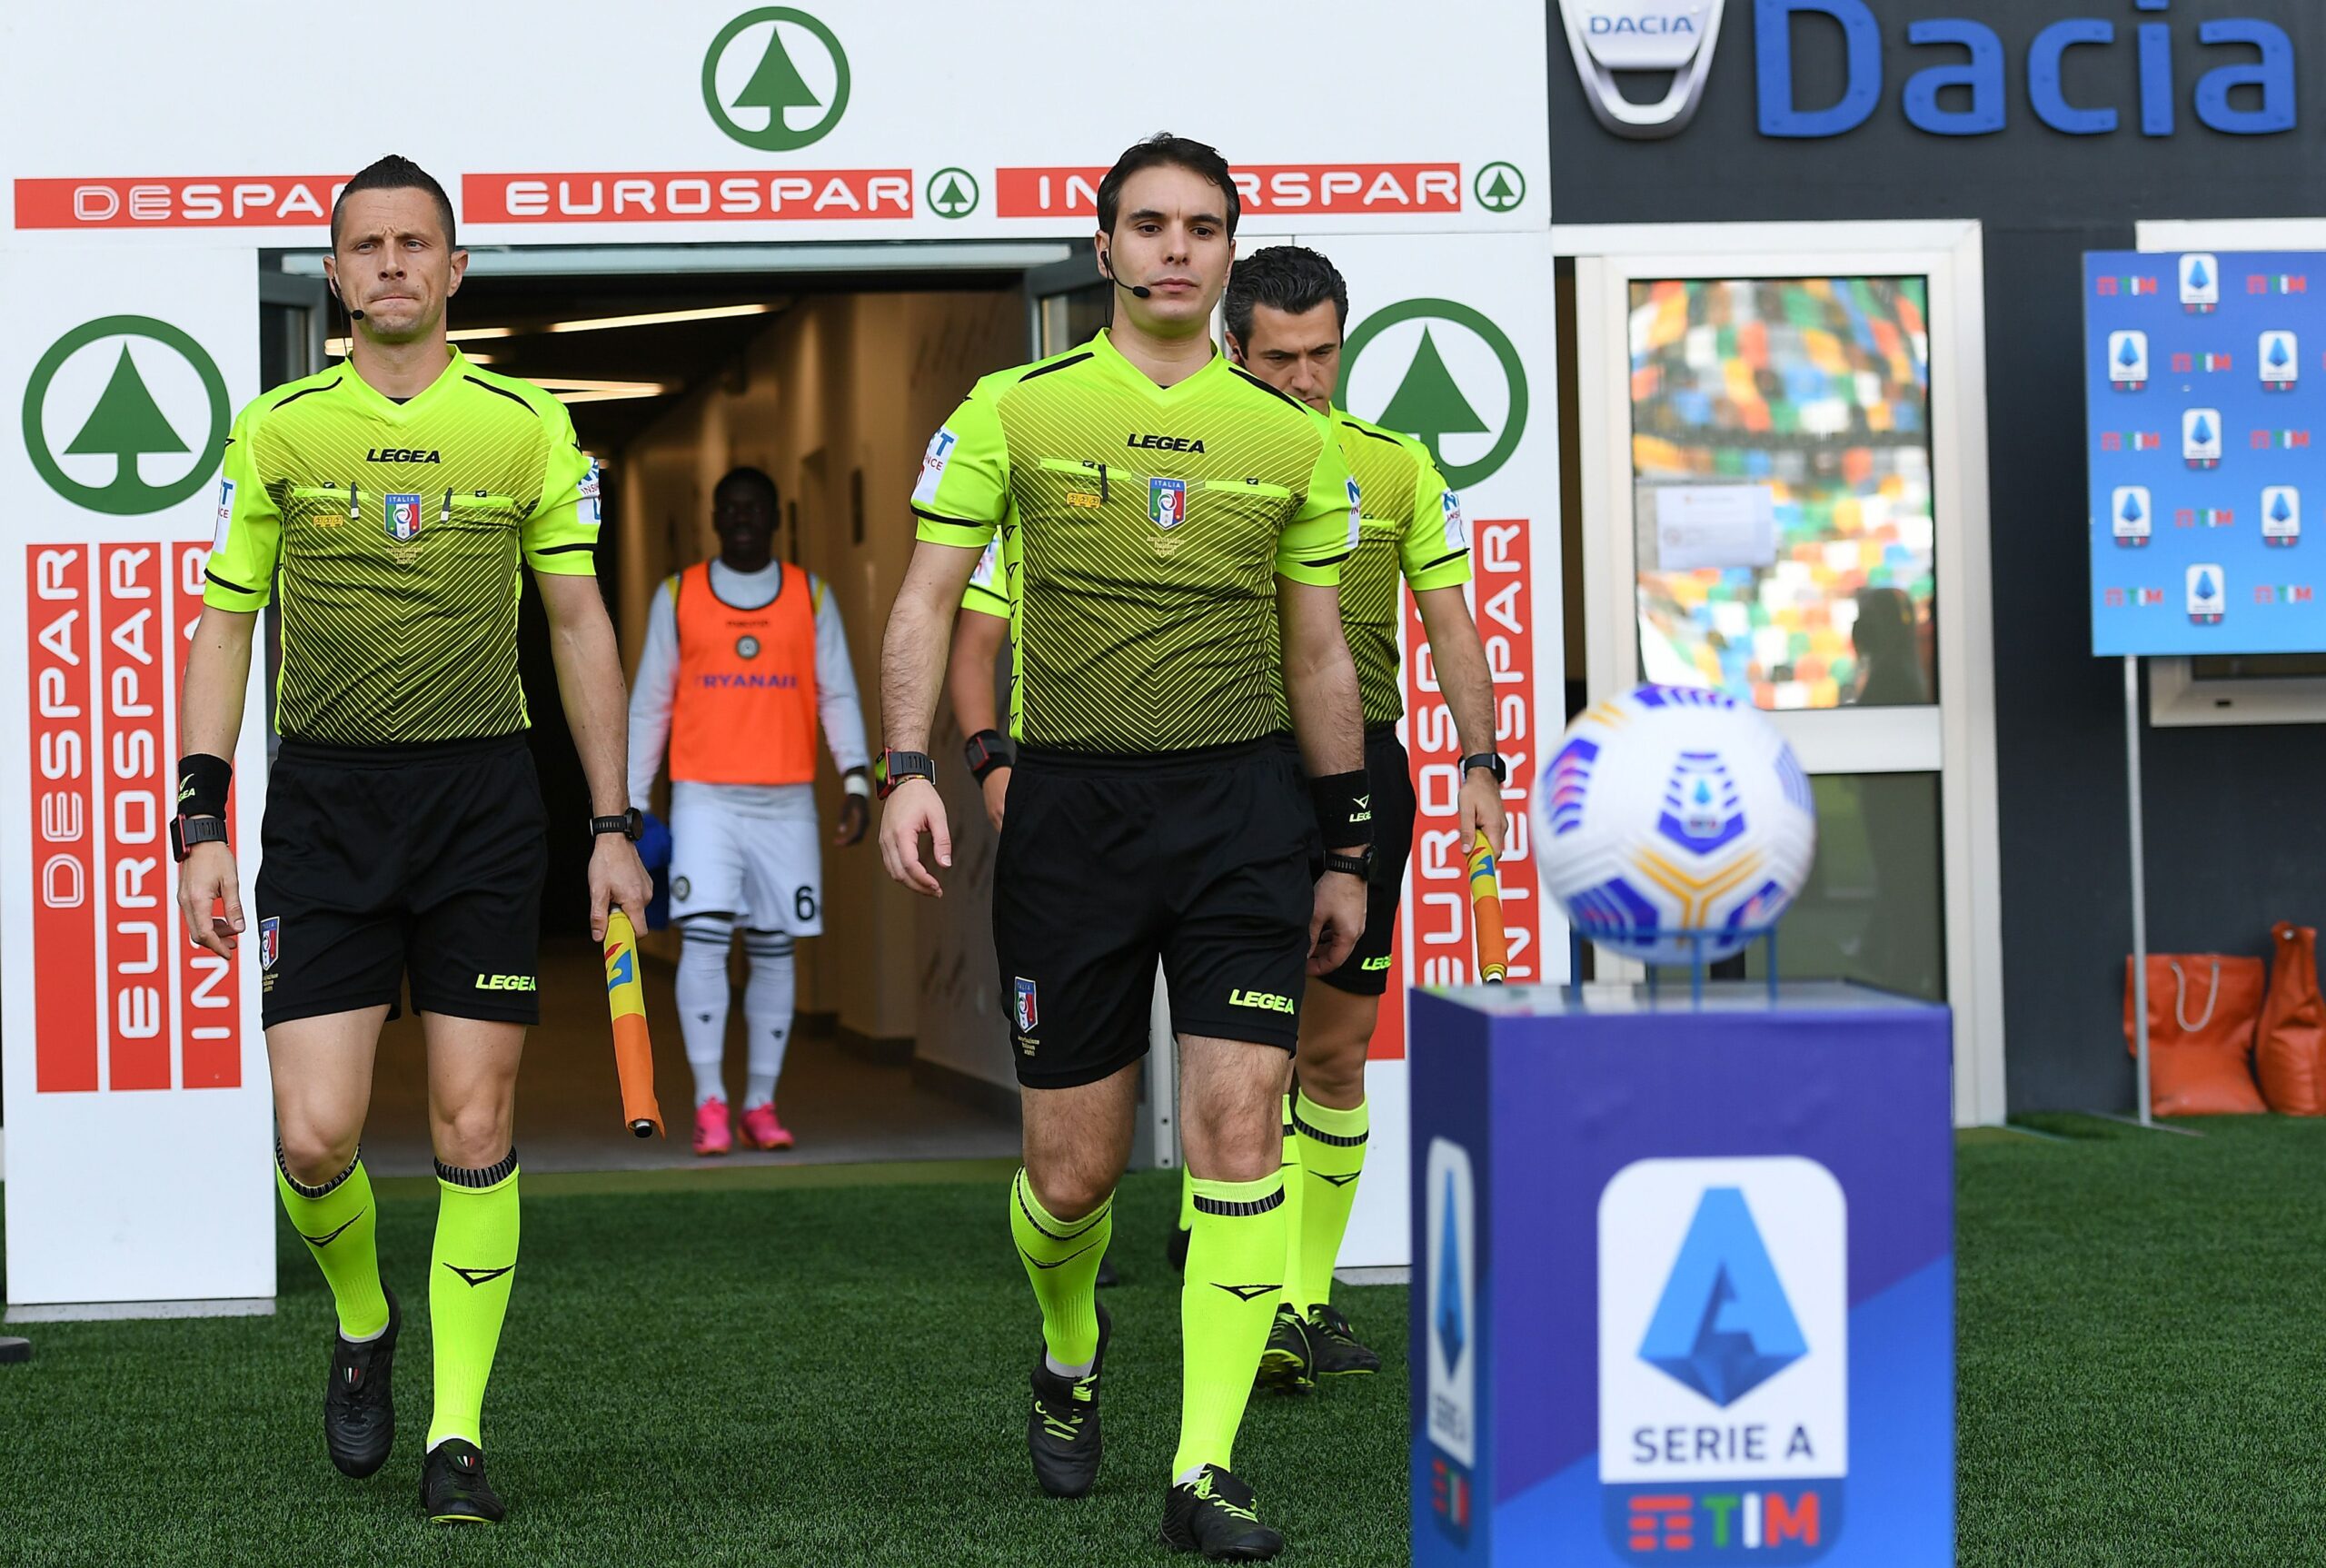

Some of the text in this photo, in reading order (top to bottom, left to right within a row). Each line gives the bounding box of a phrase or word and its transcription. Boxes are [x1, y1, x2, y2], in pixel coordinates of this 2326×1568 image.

[1590, 15, 1695, 35] DACIA
[1753, 0, 2297, 136] Dacia
[74, 184, 346, 221] DESPA
[505, 177, 910, 216] EUROSPAR
[1039, 171, 1459, 210] INRSPAR
[366, 449, 441, 463] LEGEA
[1127, 434, 1206, 453] LEGEA
[1154, 480, 1181, 489] ITALIA
[36, 548, 84, 908] DESPAR
[109, 548, 160, 1038] EUROSPAR
[1415, 607, 1465, 986] EUROSP
[795, 886, 815, 921] 6
[475, 974, 536, 991] LEGEA
[1228, 988, 1295, 1015] LEGEA
[1632, 1424, 1814, 1464] SERIE A
[1701, 1491, 1821, 1550] TIM
